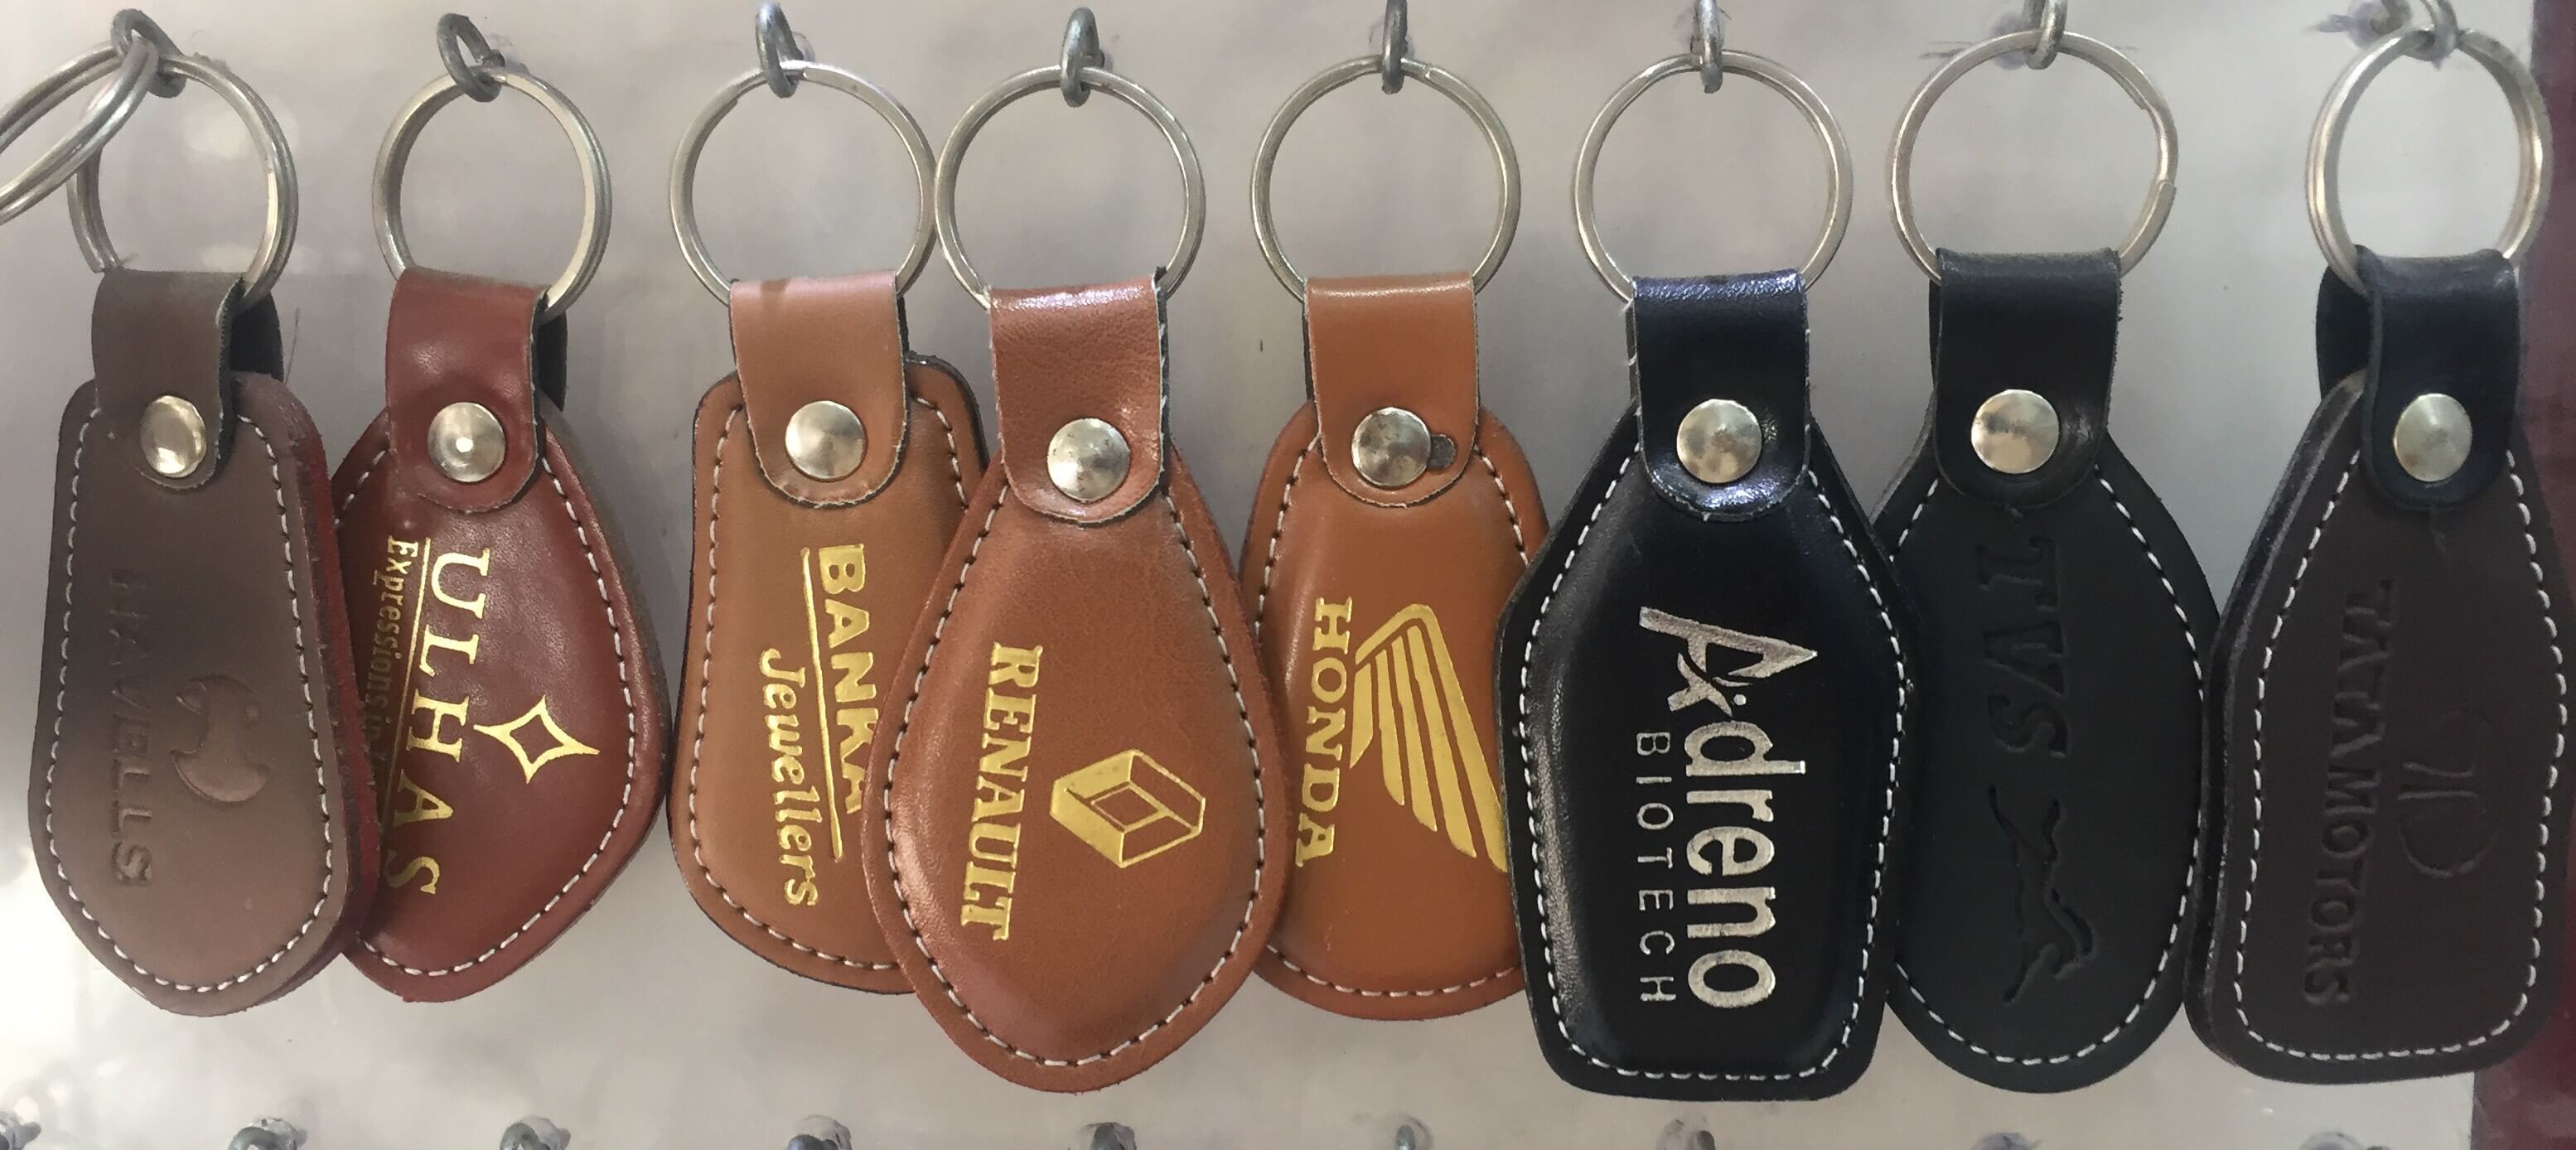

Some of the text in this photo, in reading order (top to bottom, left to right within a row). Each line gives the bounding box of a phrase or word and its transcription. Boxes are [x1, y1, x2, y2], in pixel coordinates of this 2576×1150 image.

[109, 568, 153, 885] HAVELLS
[365, 534, 419, 710] Expressions
[387, 548, 491, 895] ULHAS
[1295, 597, 1353, 867] HONDA
[1975, 534, 2070, 761] TVS
[759, 648, 823, 906] Jewellers
[960, 641, 1043, 940] RENAULT
[1636, 732, 1676, 1002] BIOTECH
